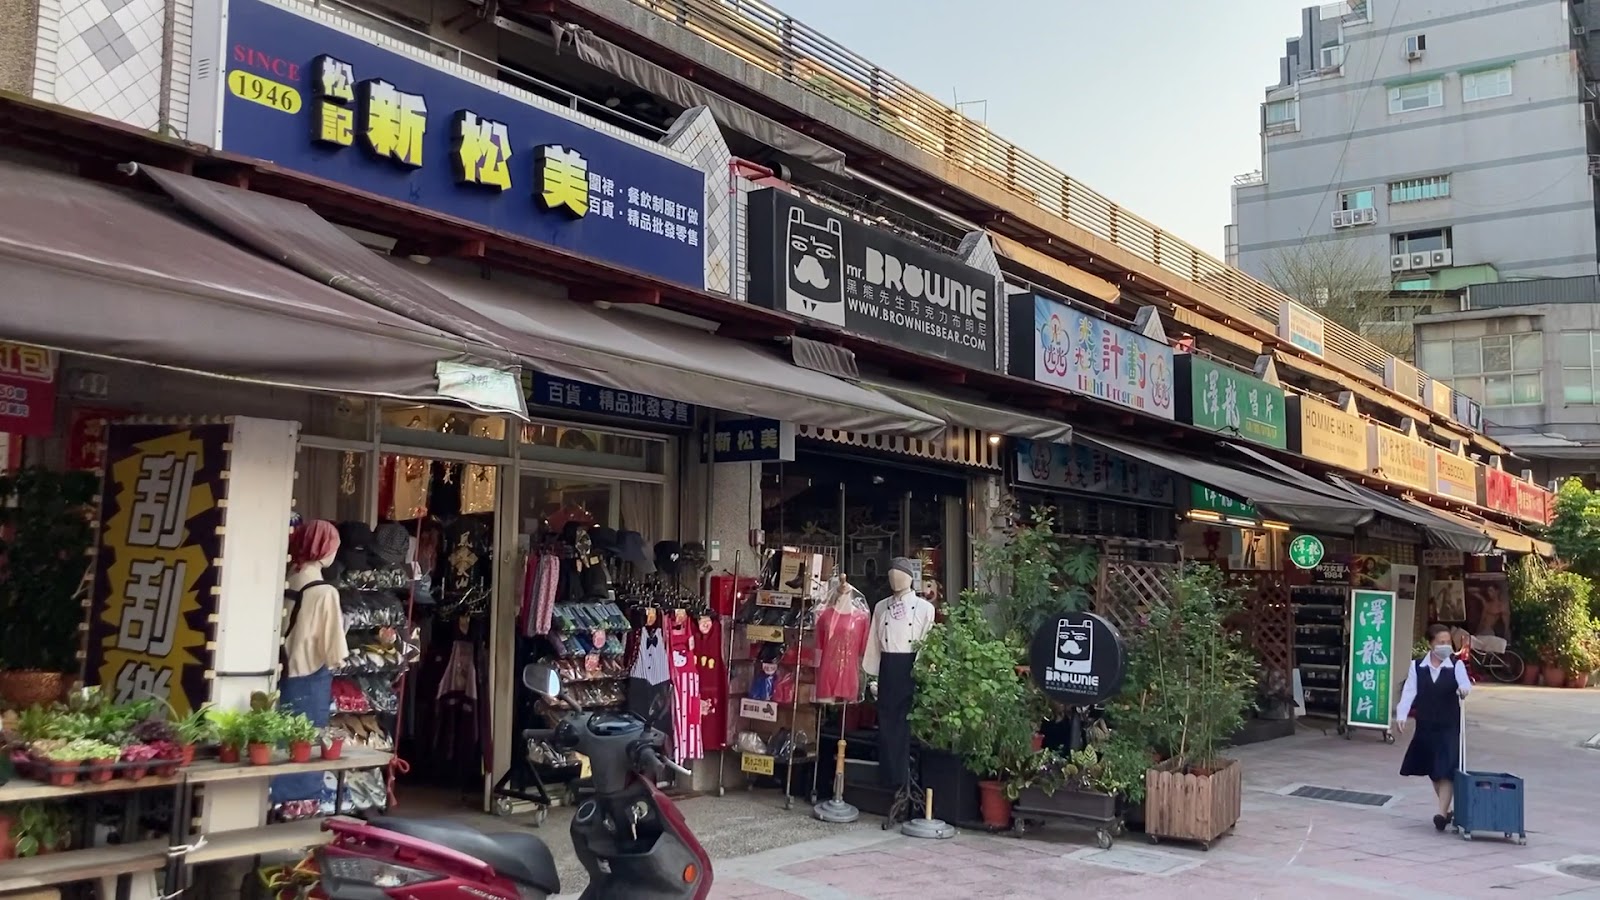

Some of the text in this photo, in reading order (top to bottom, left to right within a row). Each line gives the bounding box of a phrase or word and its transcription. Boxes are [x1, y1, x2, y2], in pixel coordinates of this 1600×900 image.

[233, 43, 300, 81] SINCE
[237, 75, 293, 111] 1946
[321, 56, 355, 146] 松記
[363, 81, 588, 217] 新松美
[846, 247, 986, 321] mr. BROWNIE
[846, 278, 987, 336] 黑熊先生巧克力布朗尼
[848, 298, 987, 351] WWW.BROWNIESBEAR.COM
[1306, 408, 1335, 434] HOMME
[1323, 571, 1343, 579] 1984
[1045, 670, 1099, 687] BROWNIE
[1355, 598, 1388, 720] 澤龍唱片
